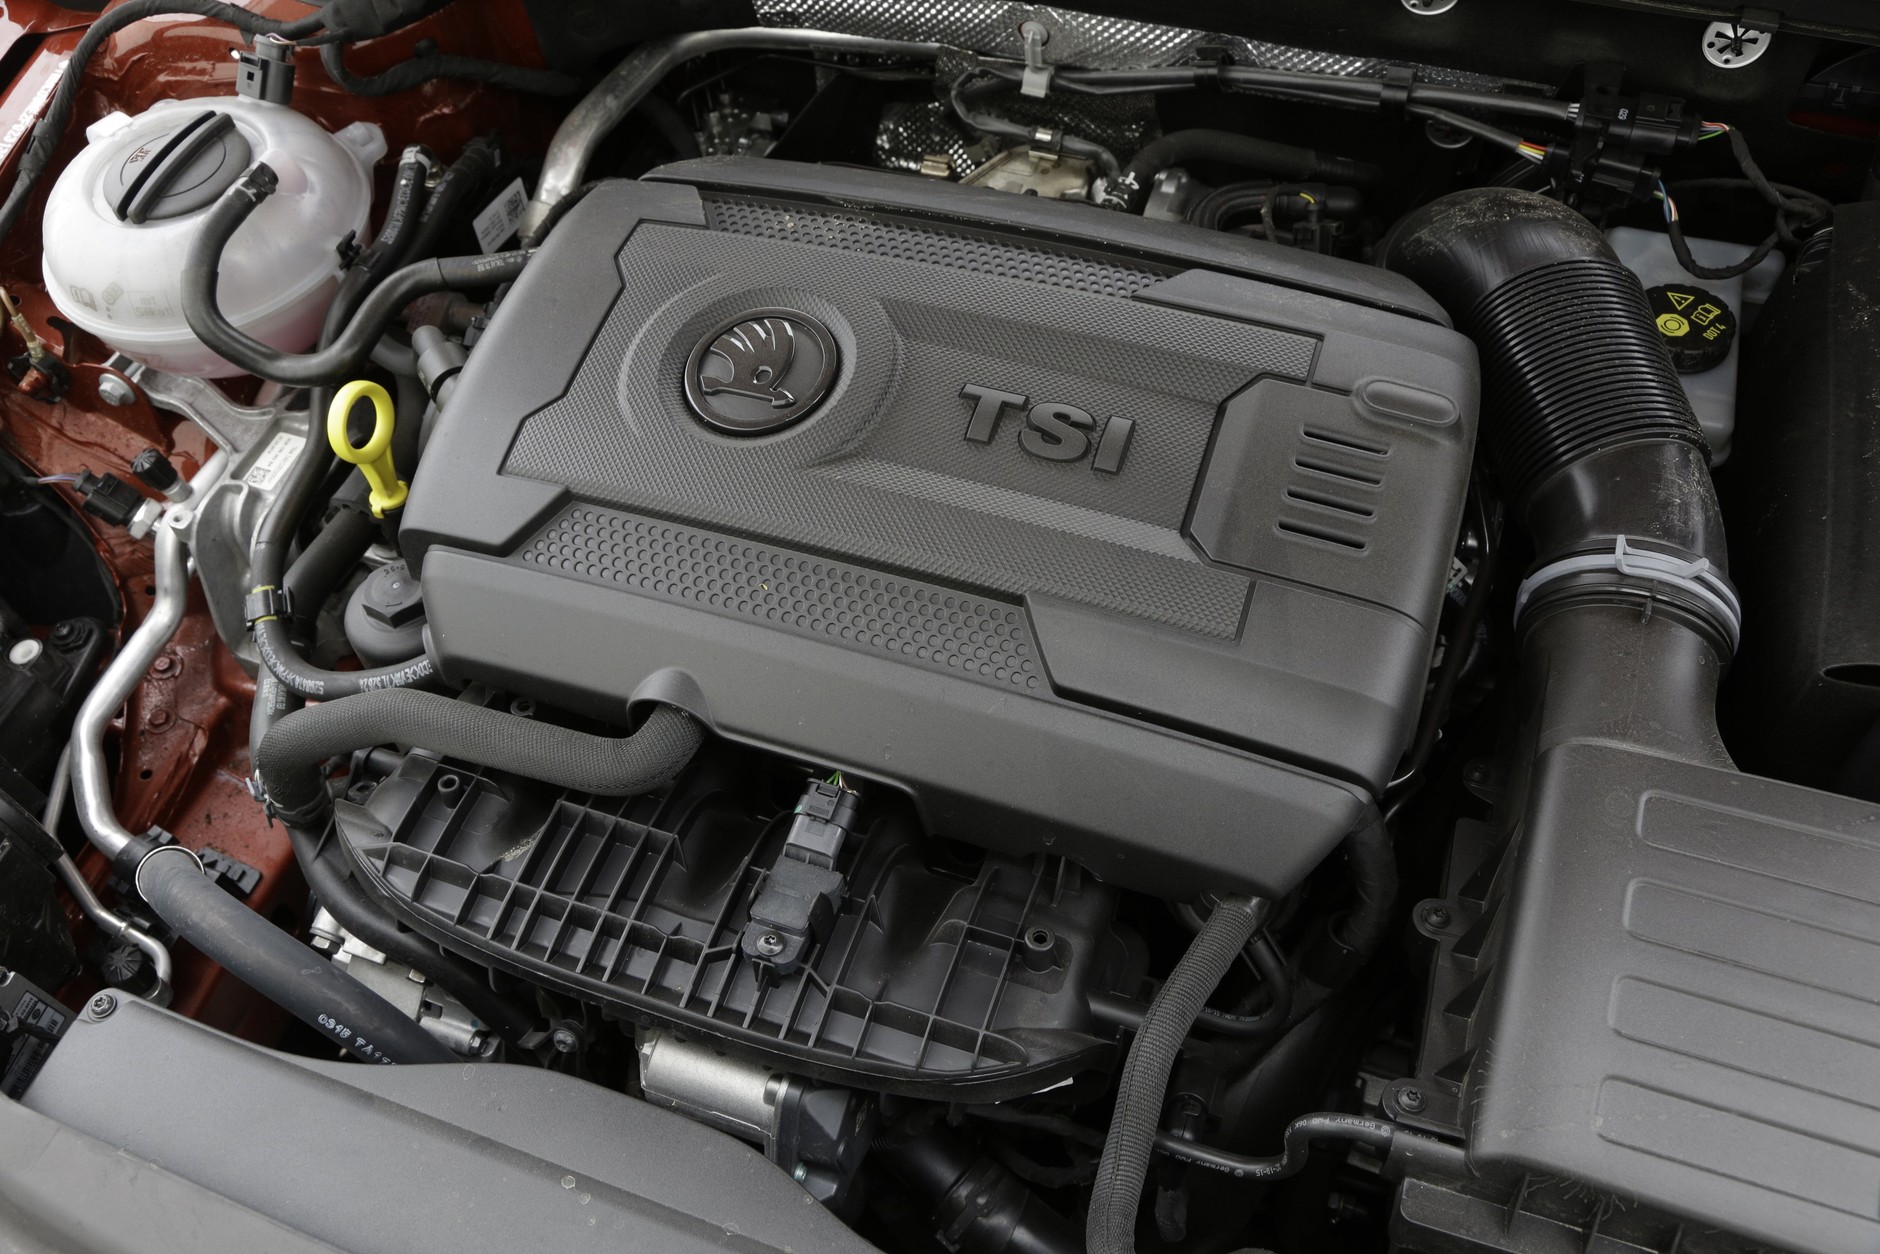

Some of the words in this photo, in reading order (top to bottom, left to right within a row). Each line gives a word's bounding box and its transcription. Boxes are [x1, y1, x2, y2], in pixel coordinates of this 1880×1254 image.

[1702, 326, 1721, 341] DOT
[1715, 322, 1727, 330] 4
[960, 383, 1138, 475] TSI
[1335, 1118, 1376, 1130] Germany
